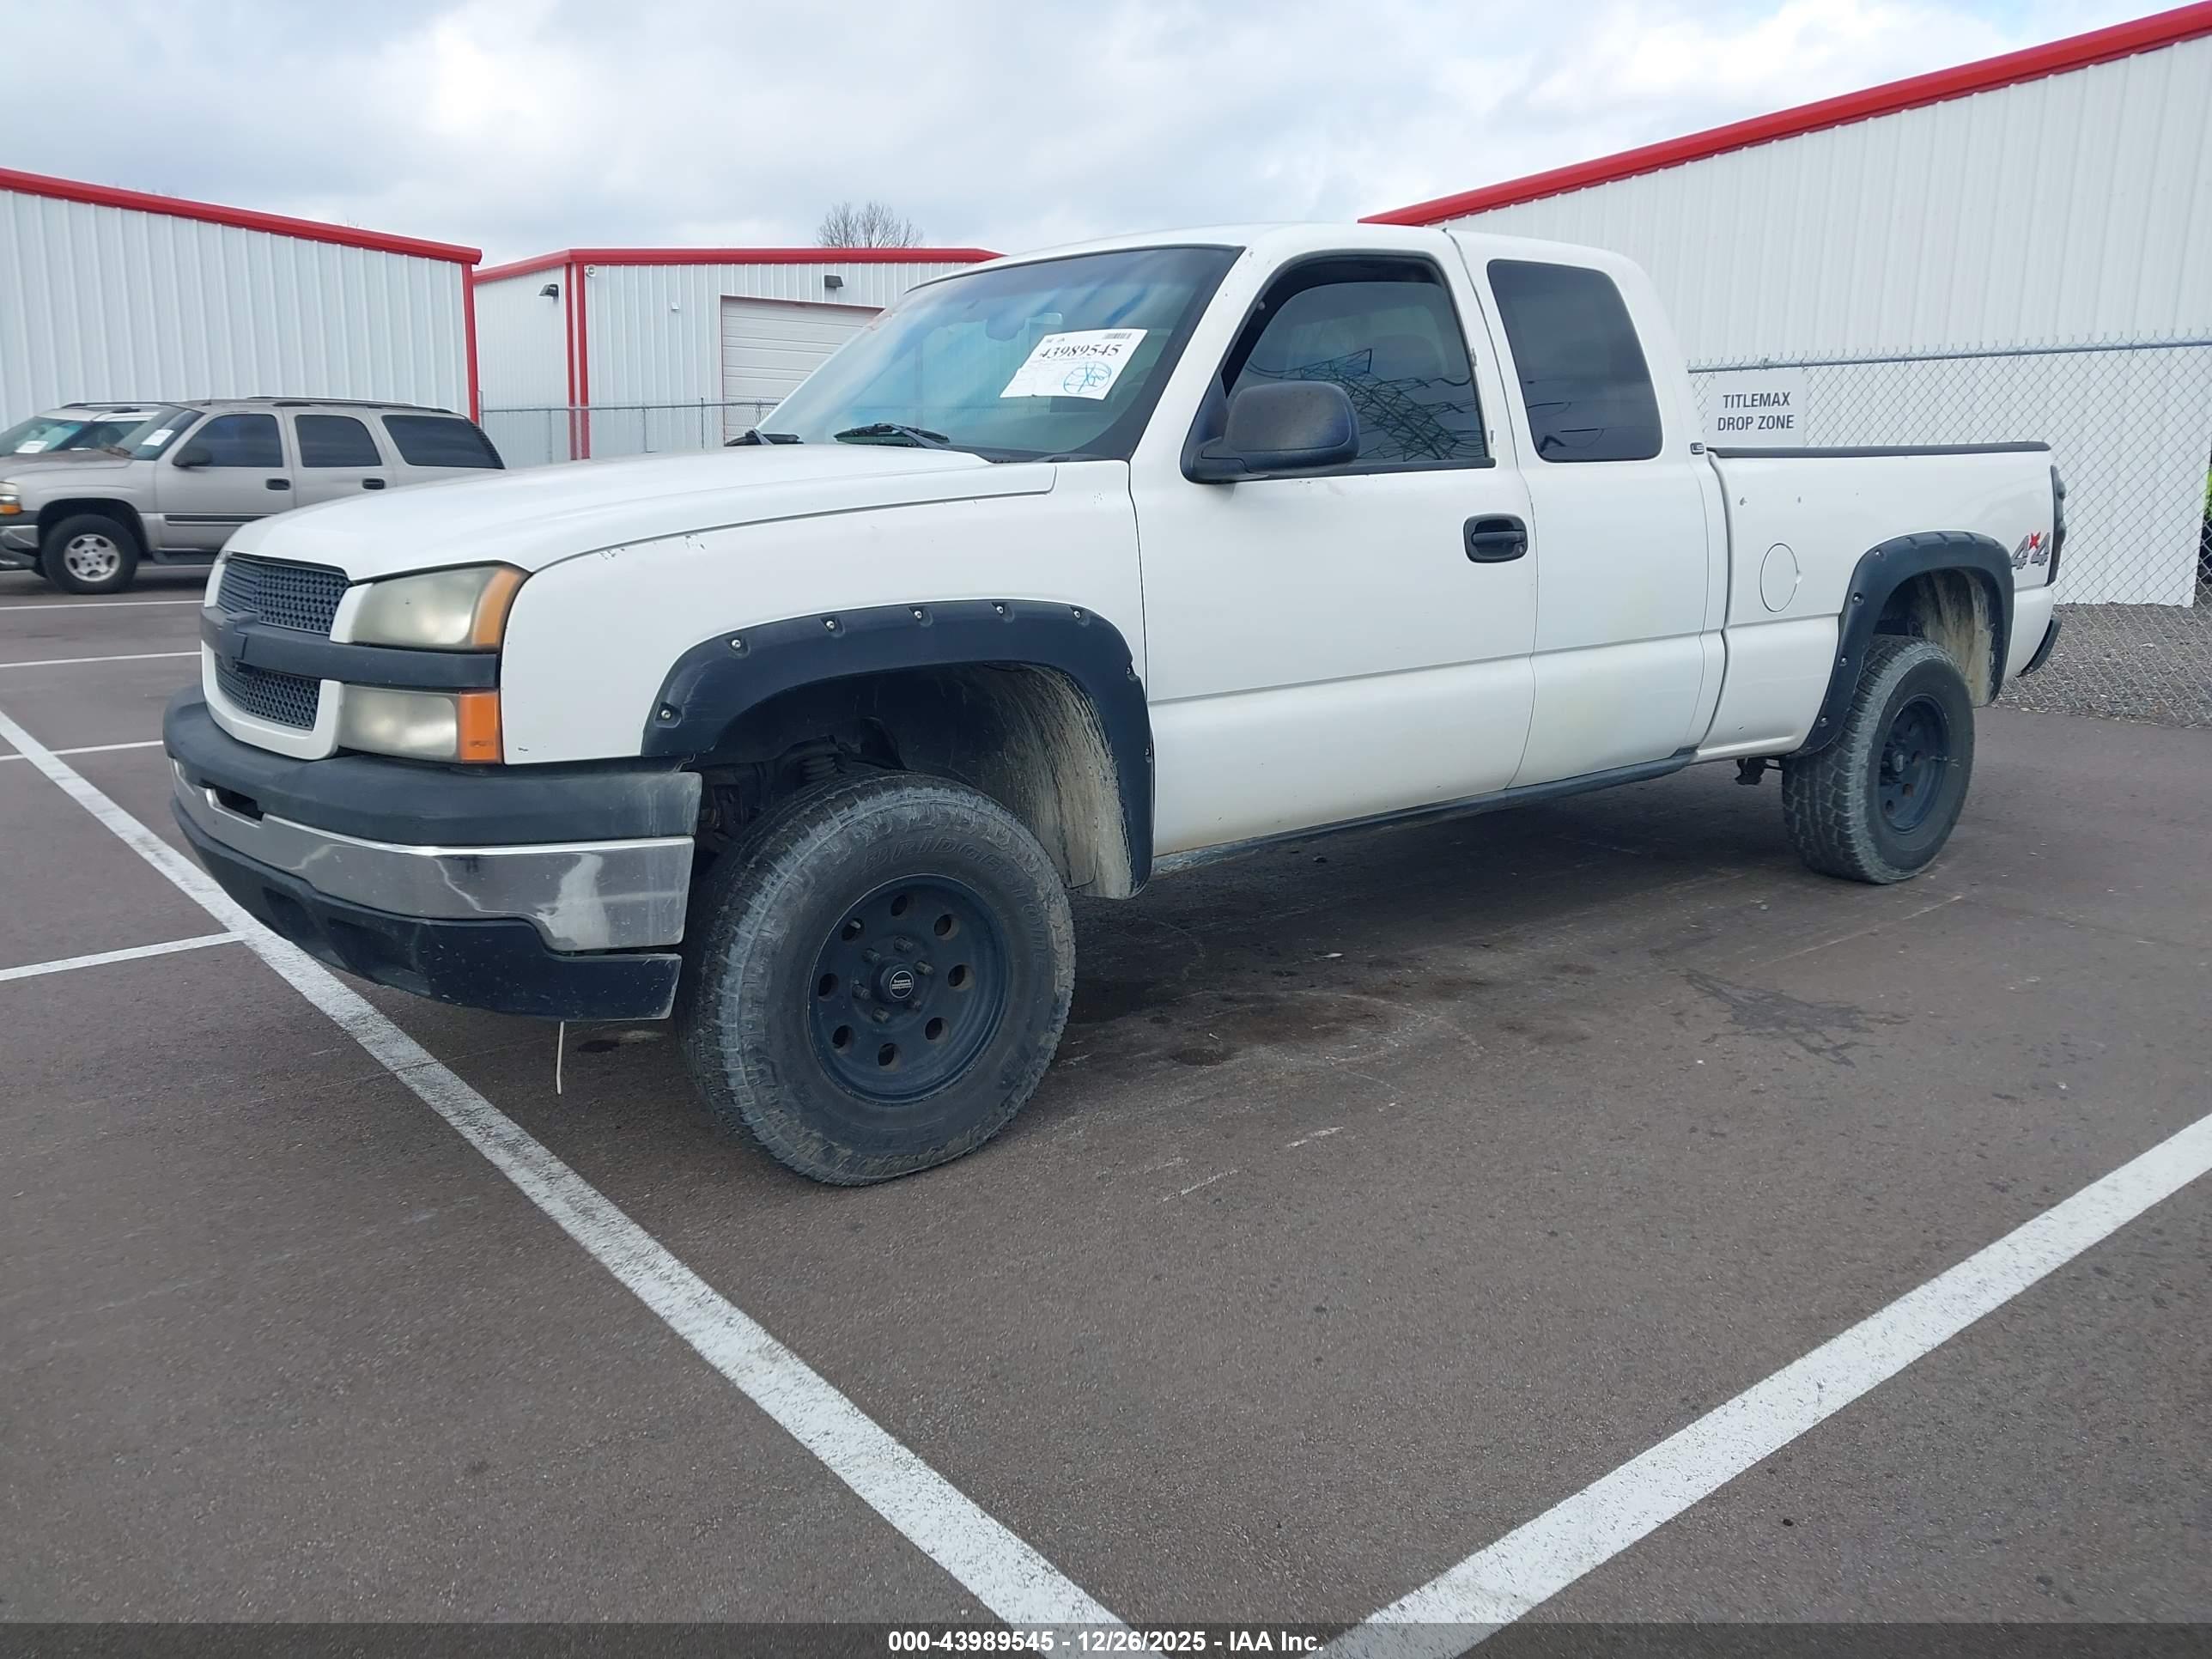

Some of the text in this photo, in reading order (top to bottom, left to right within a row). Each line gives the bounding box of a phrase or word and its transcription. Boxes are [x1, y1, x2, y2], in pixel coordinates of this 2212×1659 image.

[1040, 344, 1122, 358] 43989545
[1723, 392, 1791, 408] TITLEMAX
[1717, 415, 1795, 431] DROP ZONE
